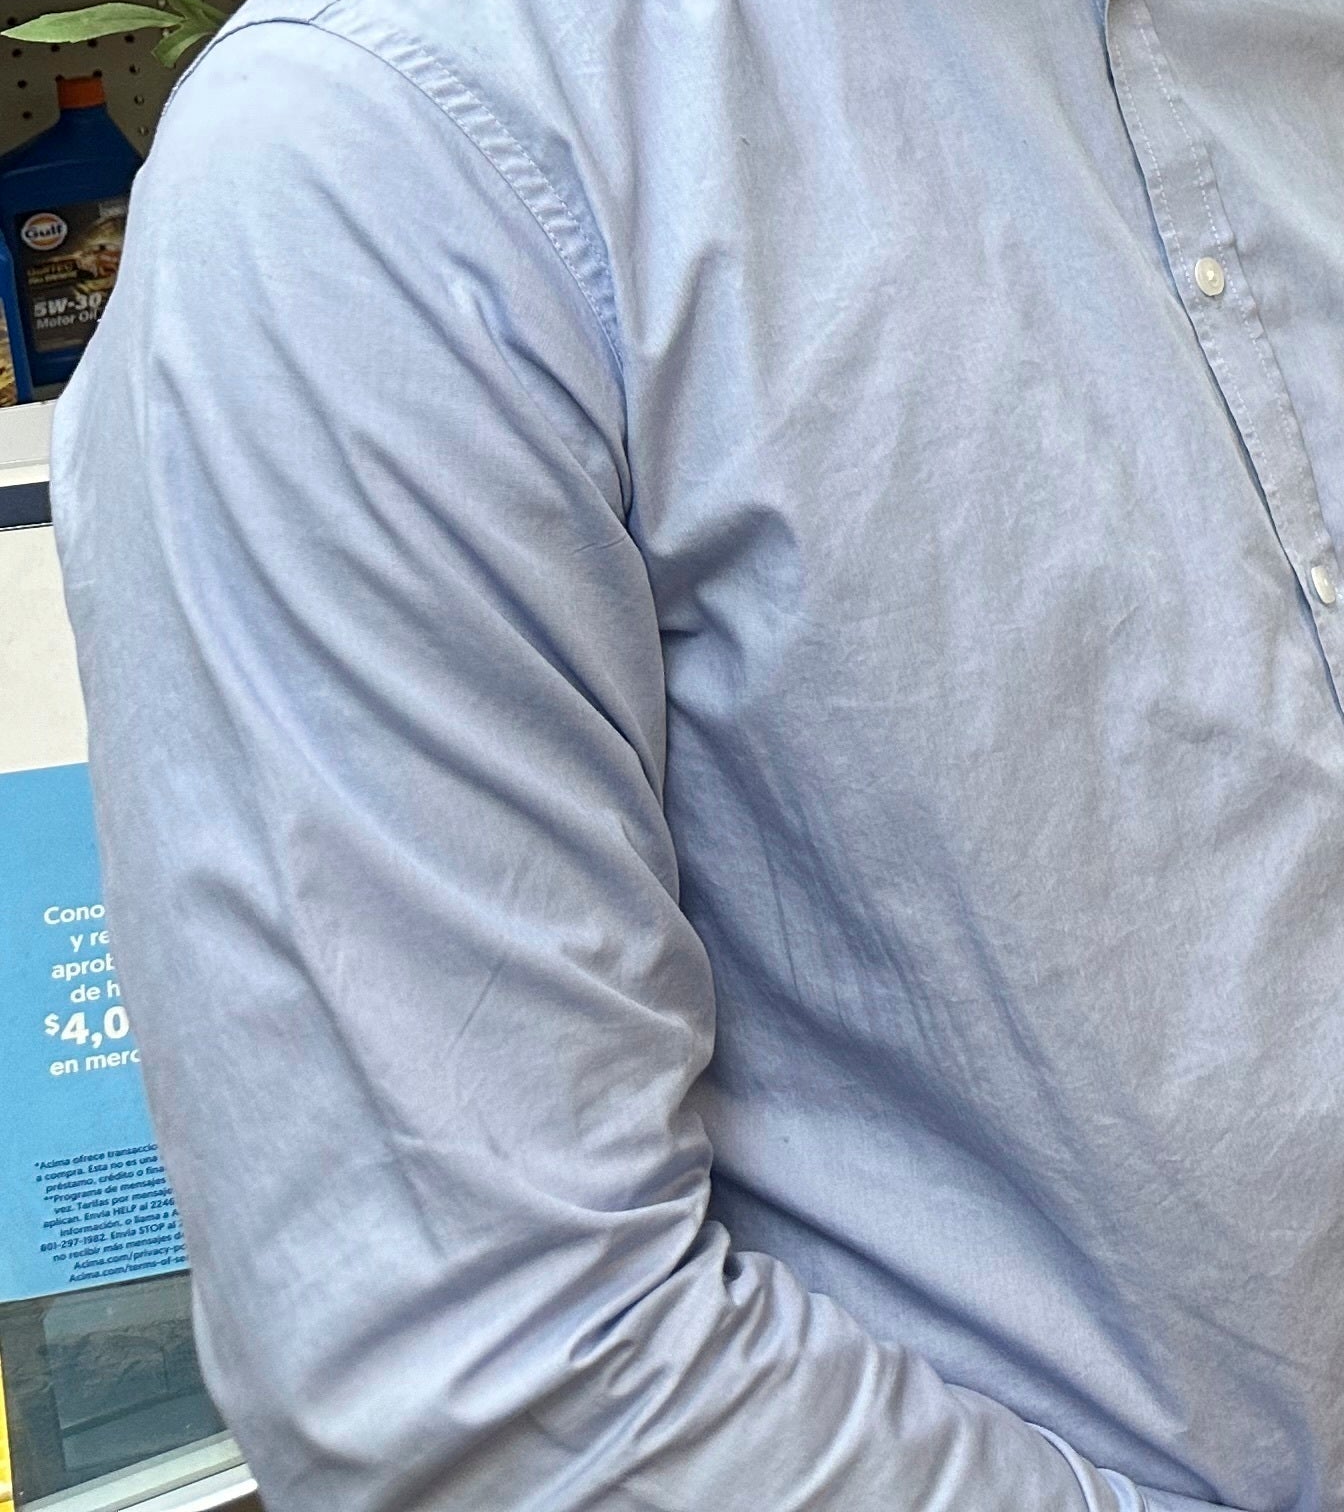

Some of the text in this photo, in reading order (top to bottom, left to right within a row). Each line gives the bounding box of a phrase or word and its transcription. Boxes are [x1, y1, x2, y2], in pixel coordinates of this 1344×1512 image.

[25, 224, 63, 239] Gulf
[43, 904, 105, 925] Cono
[69, 934, 84, 953] y
[70, 984, 101, 1003] de
[44, 1006, 130, 1049] $4,0
[50, 1048, 142, 1076] en merc
[112, 1204, 137, 1216] HELP
[139, 1222, 166, 1235] STOP
